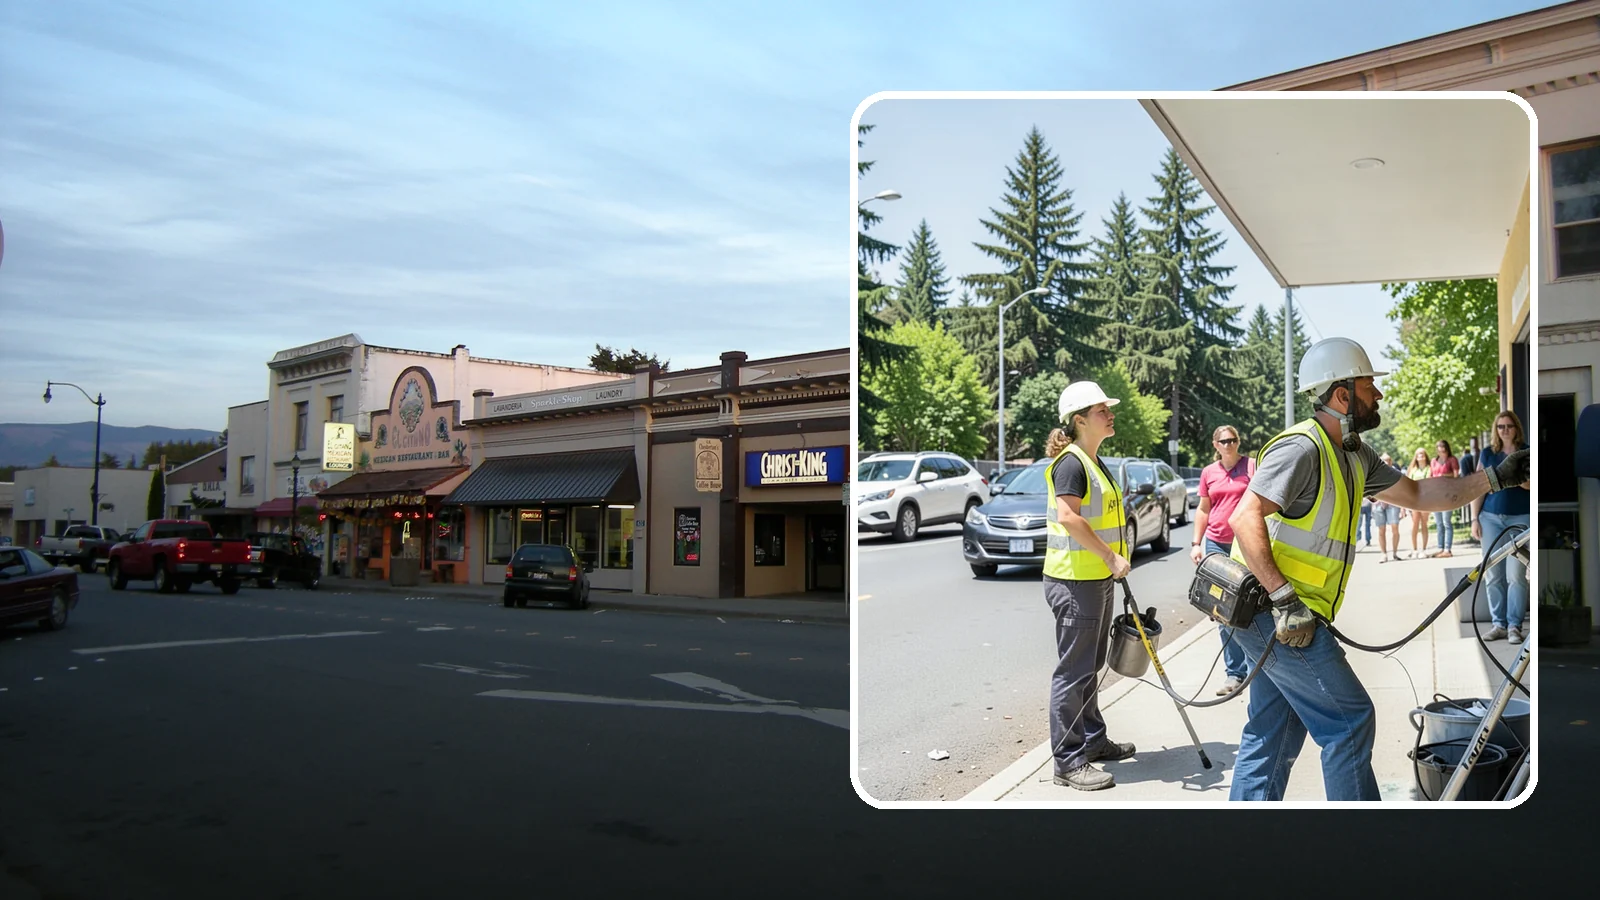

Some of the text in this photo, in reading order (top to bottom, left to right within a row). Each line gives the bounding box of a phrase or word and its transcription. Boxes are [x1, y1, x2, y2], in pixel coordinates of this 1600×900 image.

[596, 389, 623, 400] LAUNDRY
[493, 402, 522, 412] LAVANDERIA
[531, 395, 582, 409] Sparkle Shop
[374, 454, 396, 464] MEXICAN
[397, 450, 433, 462] RESTAURANT
[438, 449, 450, 459] BAR
[761, 450, 827, 478] CHRIST KING
